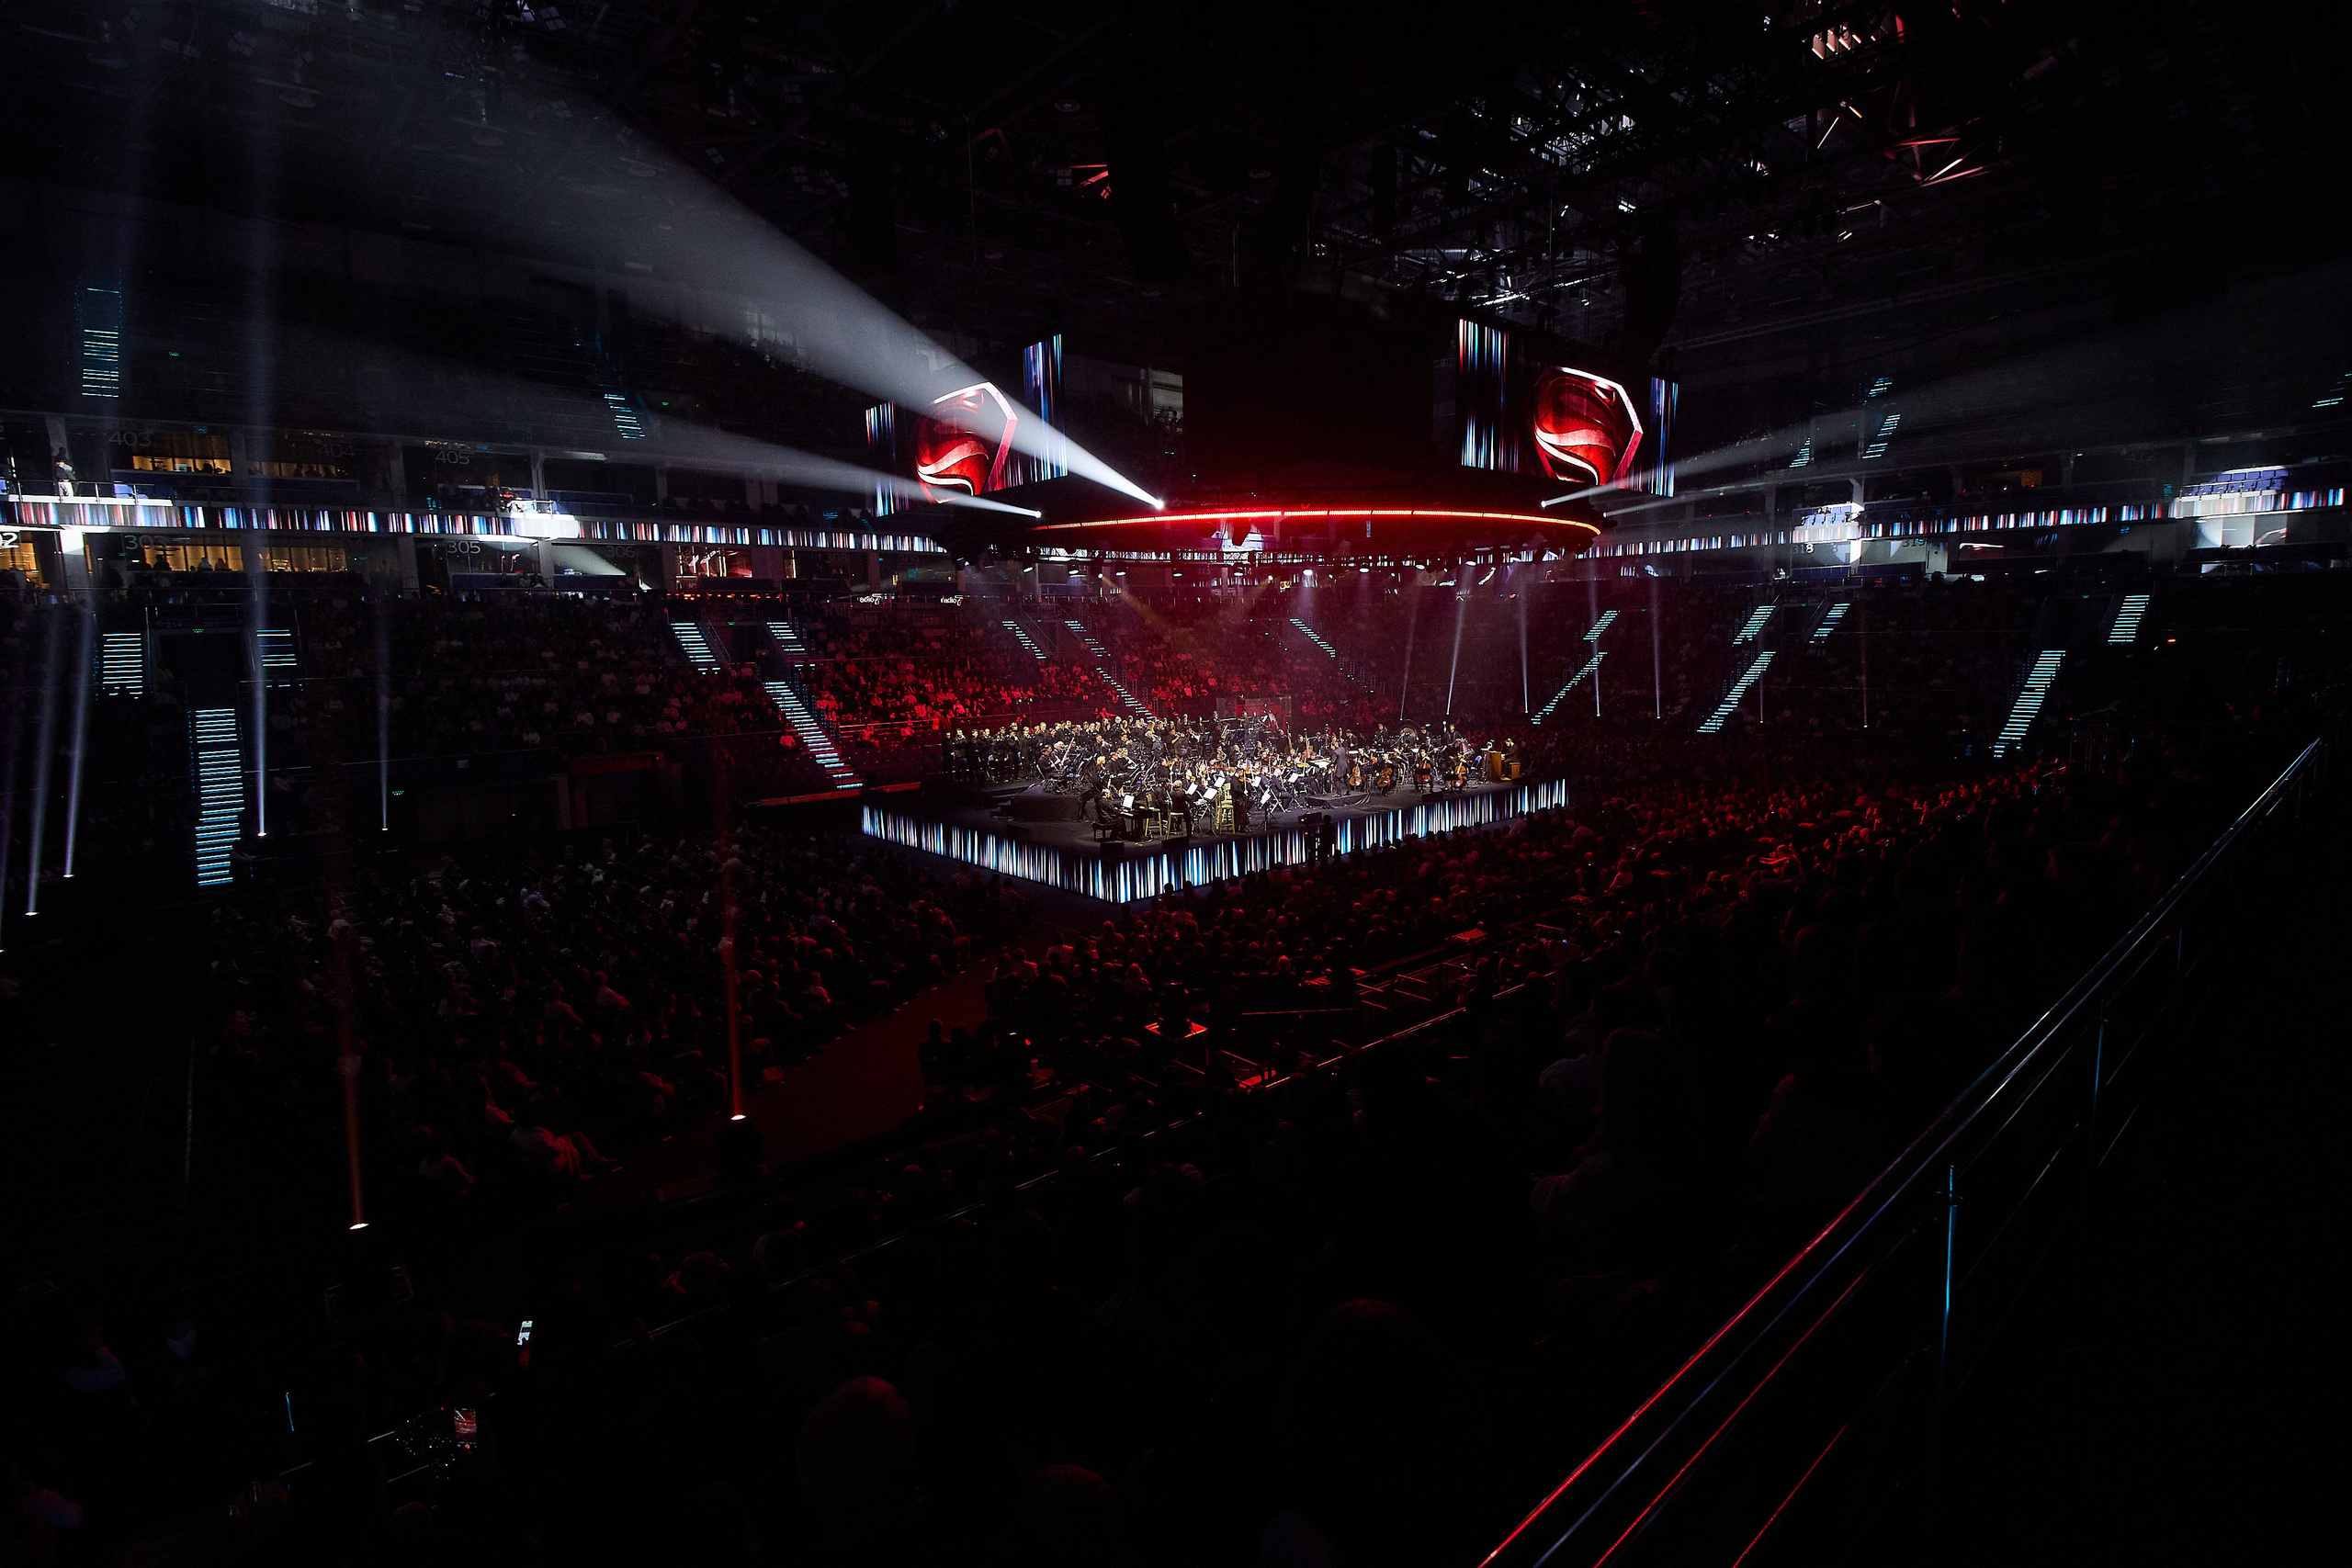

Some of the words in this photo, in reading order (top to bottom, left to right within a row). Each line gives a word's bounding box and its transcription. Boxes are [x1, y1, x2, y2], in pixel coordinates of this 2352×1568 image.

[108, 430, 152, 446] 403
[318, 443, 356, 458] 404
[435, 450, 469, 465] 405
[447, 540, 481, 554] 305
[606, 546, 635, 558] 306
[1792, 543, 1814, 554] 318
